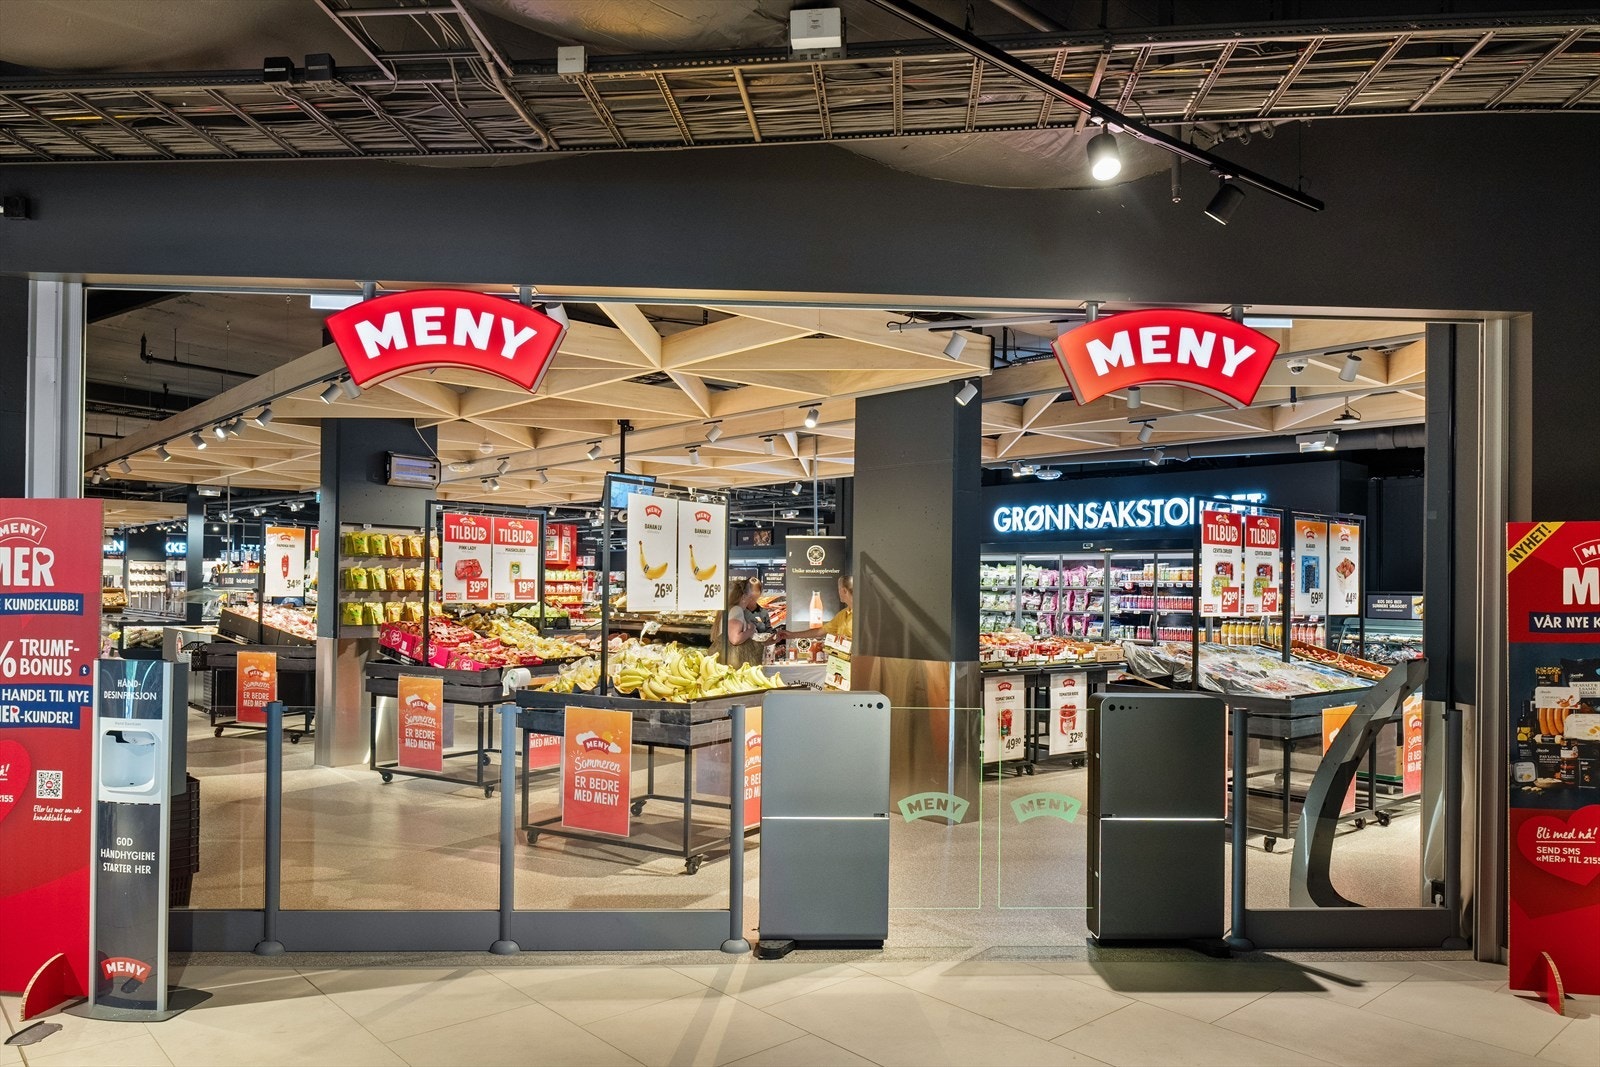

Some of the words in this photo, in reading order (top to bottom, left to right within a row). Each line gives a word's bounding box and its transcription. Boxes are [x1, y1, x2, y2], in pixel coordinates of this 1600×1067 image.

[354, 307, 538, 360] MENY
[1085, 326, 1256, 377] MENY
[449, 525, 487, 541] TILBUD
[498, 528, 534, 544] TILBUD
[1207, 524, 1238, 543] TILBUD
[1249, 528, 1276, 545] TILBUD
[1508, 523, 1552, 563] NYHET!
[4, 598, 79, 612] KUNDEKLUBB!
[1534, 615, 1562, 629] VÅR
[1566, 618, 1589, 629] NYE
[20, 638, 80, 657] TRUMF-
[20, 658, 72, 676] BONUS
[117, 678, 141, 687] HÅND-
[2, 688, 47, 702] HANDEL
[49, 690, 64, 702] TIL
[68, 690, 89, 703] NYE
[103, 690, 157, 700] DESINFEKSJON
[0, 705, 73, 724] ER-KUNDER!
[405, 728, 414, 738] ER
[415, 730, 436, 740] BEDRE
[404, 738, 417, 749] MED
[418, 740, 436, 751] MENY
[585, 740, 609, 750] MENY
[574, 756, 621, 773] Sommeren
[574, 775, 586, 789] ER
[589, 778, 620, 793] BEDRE
[573, 788, 592, 801] MED
[593, 791, 620, 807] MENY
[906, 798, 962, 815] MENY
[1019, 798, 1073, 815] MENY
[1536, 826, 1551, 839] Bli
[1553, 828, 1577, 839] med
[1578, 827, 1598, 839] nå!
[116, 837, 133, 847] GOD
[101, 848, 155, 861] HÅNDHYGIENE
[1536, 846, 1561, 854] SEND
[1563, 847, 1581, 855] SMS
[1536, 855, 1566, 863] «MER»
[1568, 856, 1582, 864] TIL
[103, 862, 131, 873] STARTER
[134, 865, 151, 874] HER
[106, 961, 146, 976] MENY
